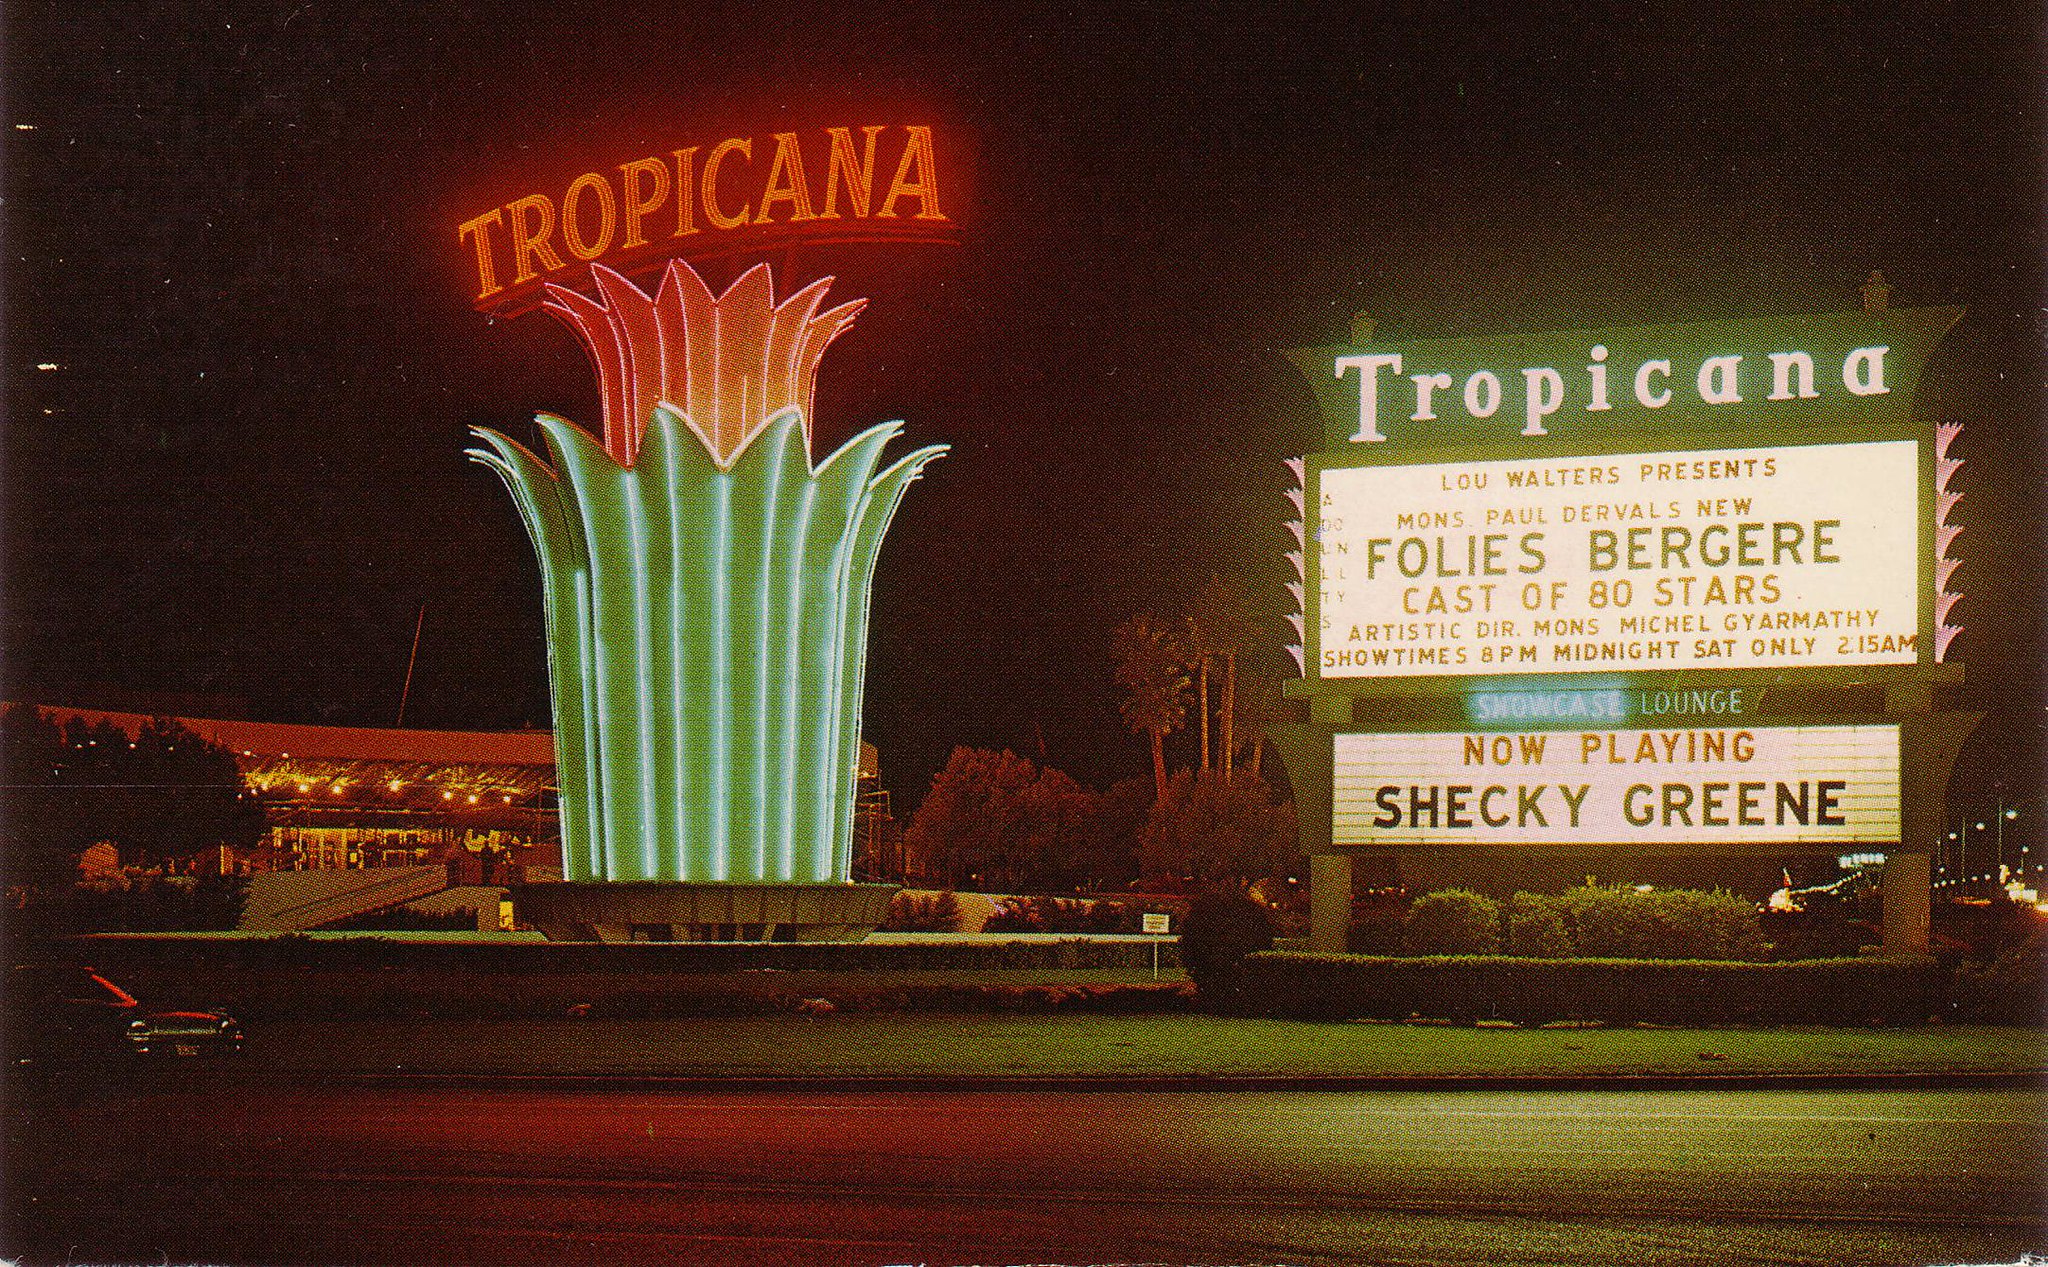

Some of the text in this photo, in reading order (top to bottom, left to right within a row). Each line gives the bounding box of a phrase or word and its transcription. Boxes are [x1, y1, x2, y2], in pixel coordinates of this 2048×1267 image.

[458, 125, 946, 300] TROPICANA
[1335, 345, 1890, 442] Tropicana
[1441, 457, 1777, 491] LOU WALTERS PRESENTS
[1486, 507, 1548, 526] PAUL
[1562, 502, 1681, 522] DERVALS
[1697, 497, 1752, 517] NEW
[1367, 519, 1841, 580] FOLIES BERGERE
[1402, 573, 1781, 614] CAST OF 80 STARS
[1348, 608, 1880, 642] ARTISTIC DIR. MONS MICHEL GYARMATHY
[1322, 645, 1467, 667] SHOWTIMES
[1554, 640, 1680, 662] MIDNIGHT
[1694, 638, 1737, 658] SAT
[1751, 636, 1816, 657] ONLY
[1476, 689, 1742, 719] SHOWCASE LOUNGE
[1463, 730, 1756, 766] NOW PLAYING
[1373, 780, 1846, 830] SHECKY GREENE
